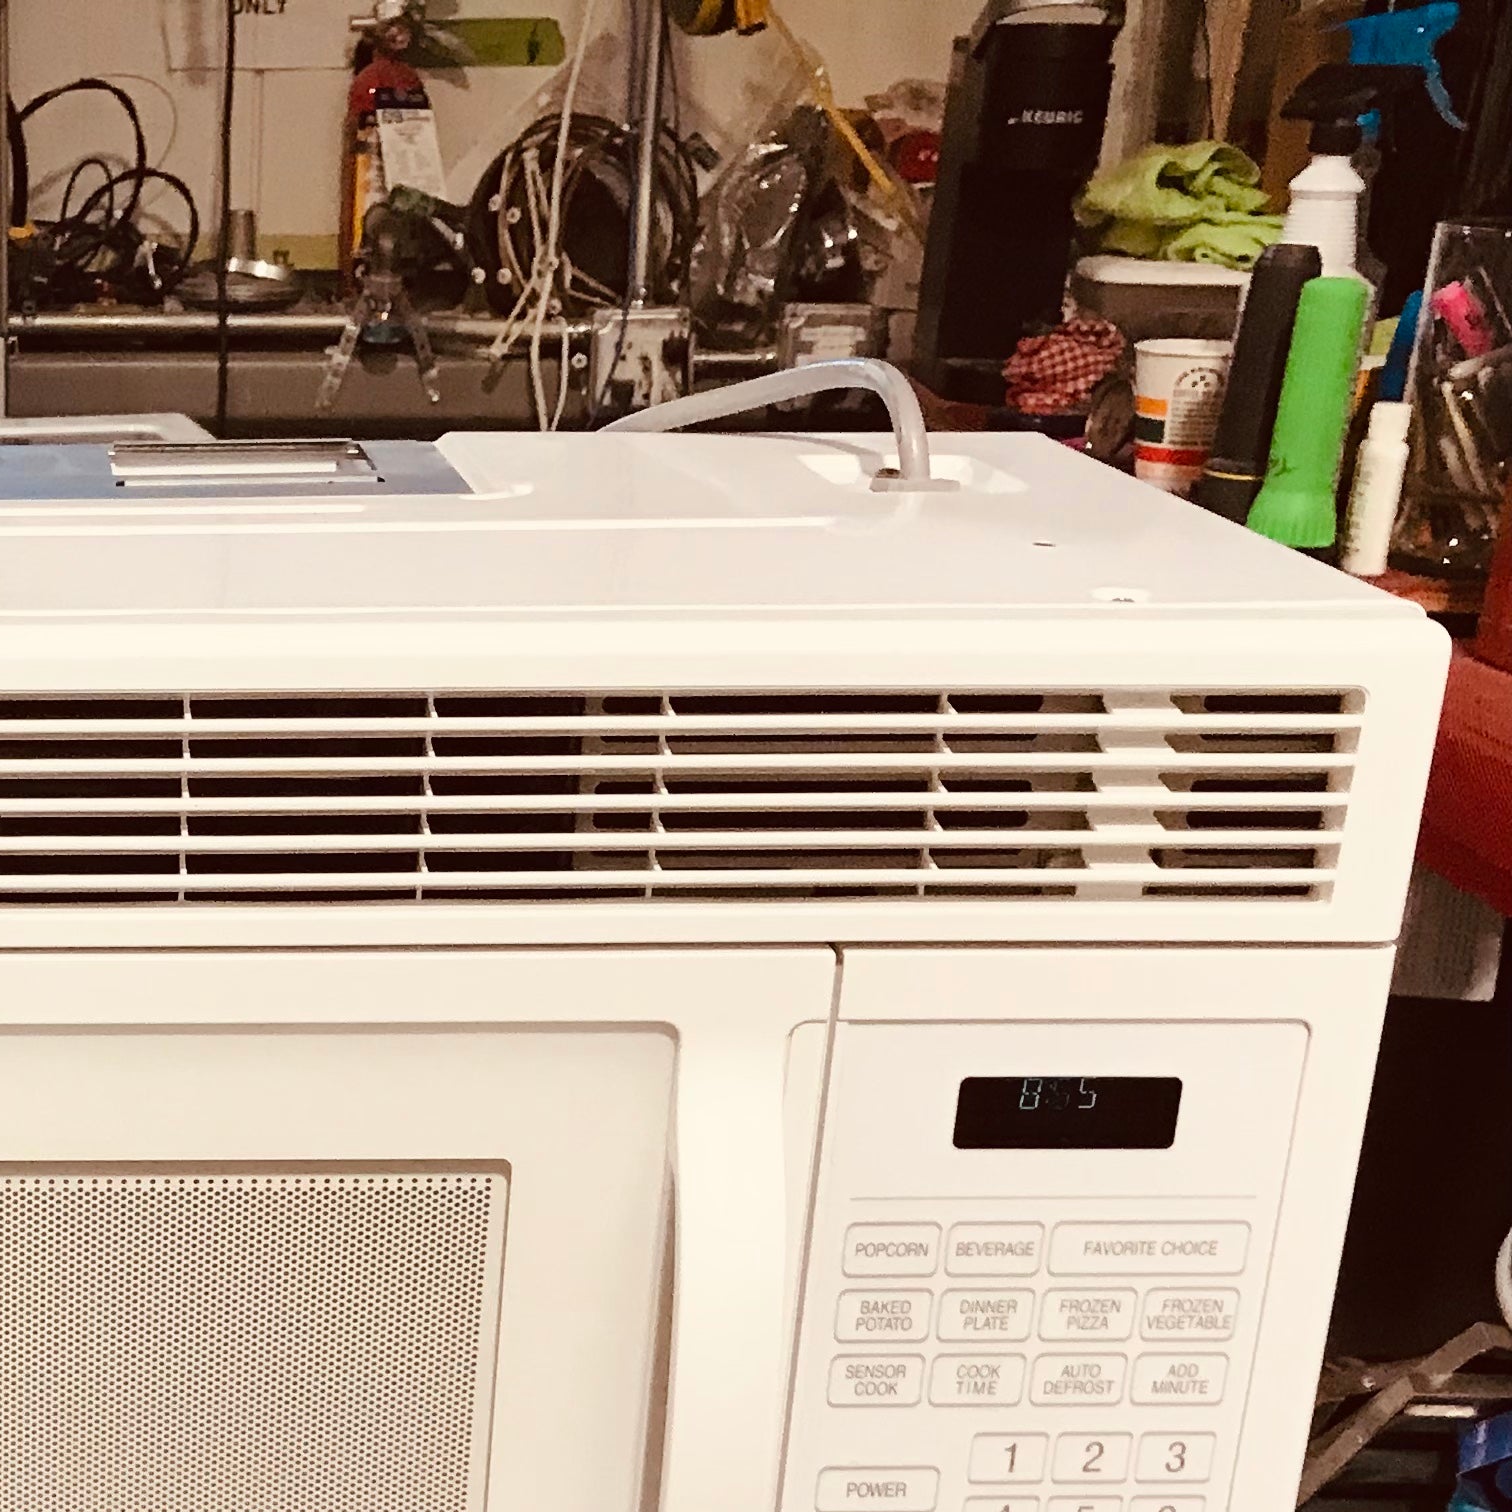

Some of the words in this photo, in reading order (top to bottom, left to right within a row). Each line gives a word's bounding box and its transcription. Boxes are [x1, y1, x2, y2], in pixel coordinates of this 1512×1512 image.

[854, 1242, 929, 1257] POPCORN
[955, 1241, 1035, 1257] BEVERAGE
[1083, 1240, 1157, 1256] FAVORITE
[1160, 1240, 1219, 1256] CHOICE
[860, 1299, 912, 1315] BAKED
[959, 1299, 1018, 1315] DINNER
[1059, 1298, 1122, 1314] FROZEN
[1161, 1298, 1224, 1314] FROZEN
[855, 1316, 913, 1331] POTATO
[963, 1316, 1009, 1331] PLATE
[1066, 1315, 1109, 1330] PIZZA
[1147, 1315, 1233, 1330] VEGETABLE
[845, 1364, 907, 1379] SENSOR
[956, 1364, 1001, 1379] COOK
[1060, 1363, 1102, 1378] AUTO
[1167, 1363, 1199, 1378] ADD
[854, 1381, 898, 1396] COOK
[956, 1381, 999, 1396] TIME
[1043, 1380, 1115, 1395] DEFROST
[1151, 1380, 1209, 1394] MINUTE
[1004, 1442, 1018, 1473] 1
[1082, 1441, 1104, 1473] 2
[1165, 1441, 1187, 1473] 3
[846, 1482, 907, 1498] POWER
